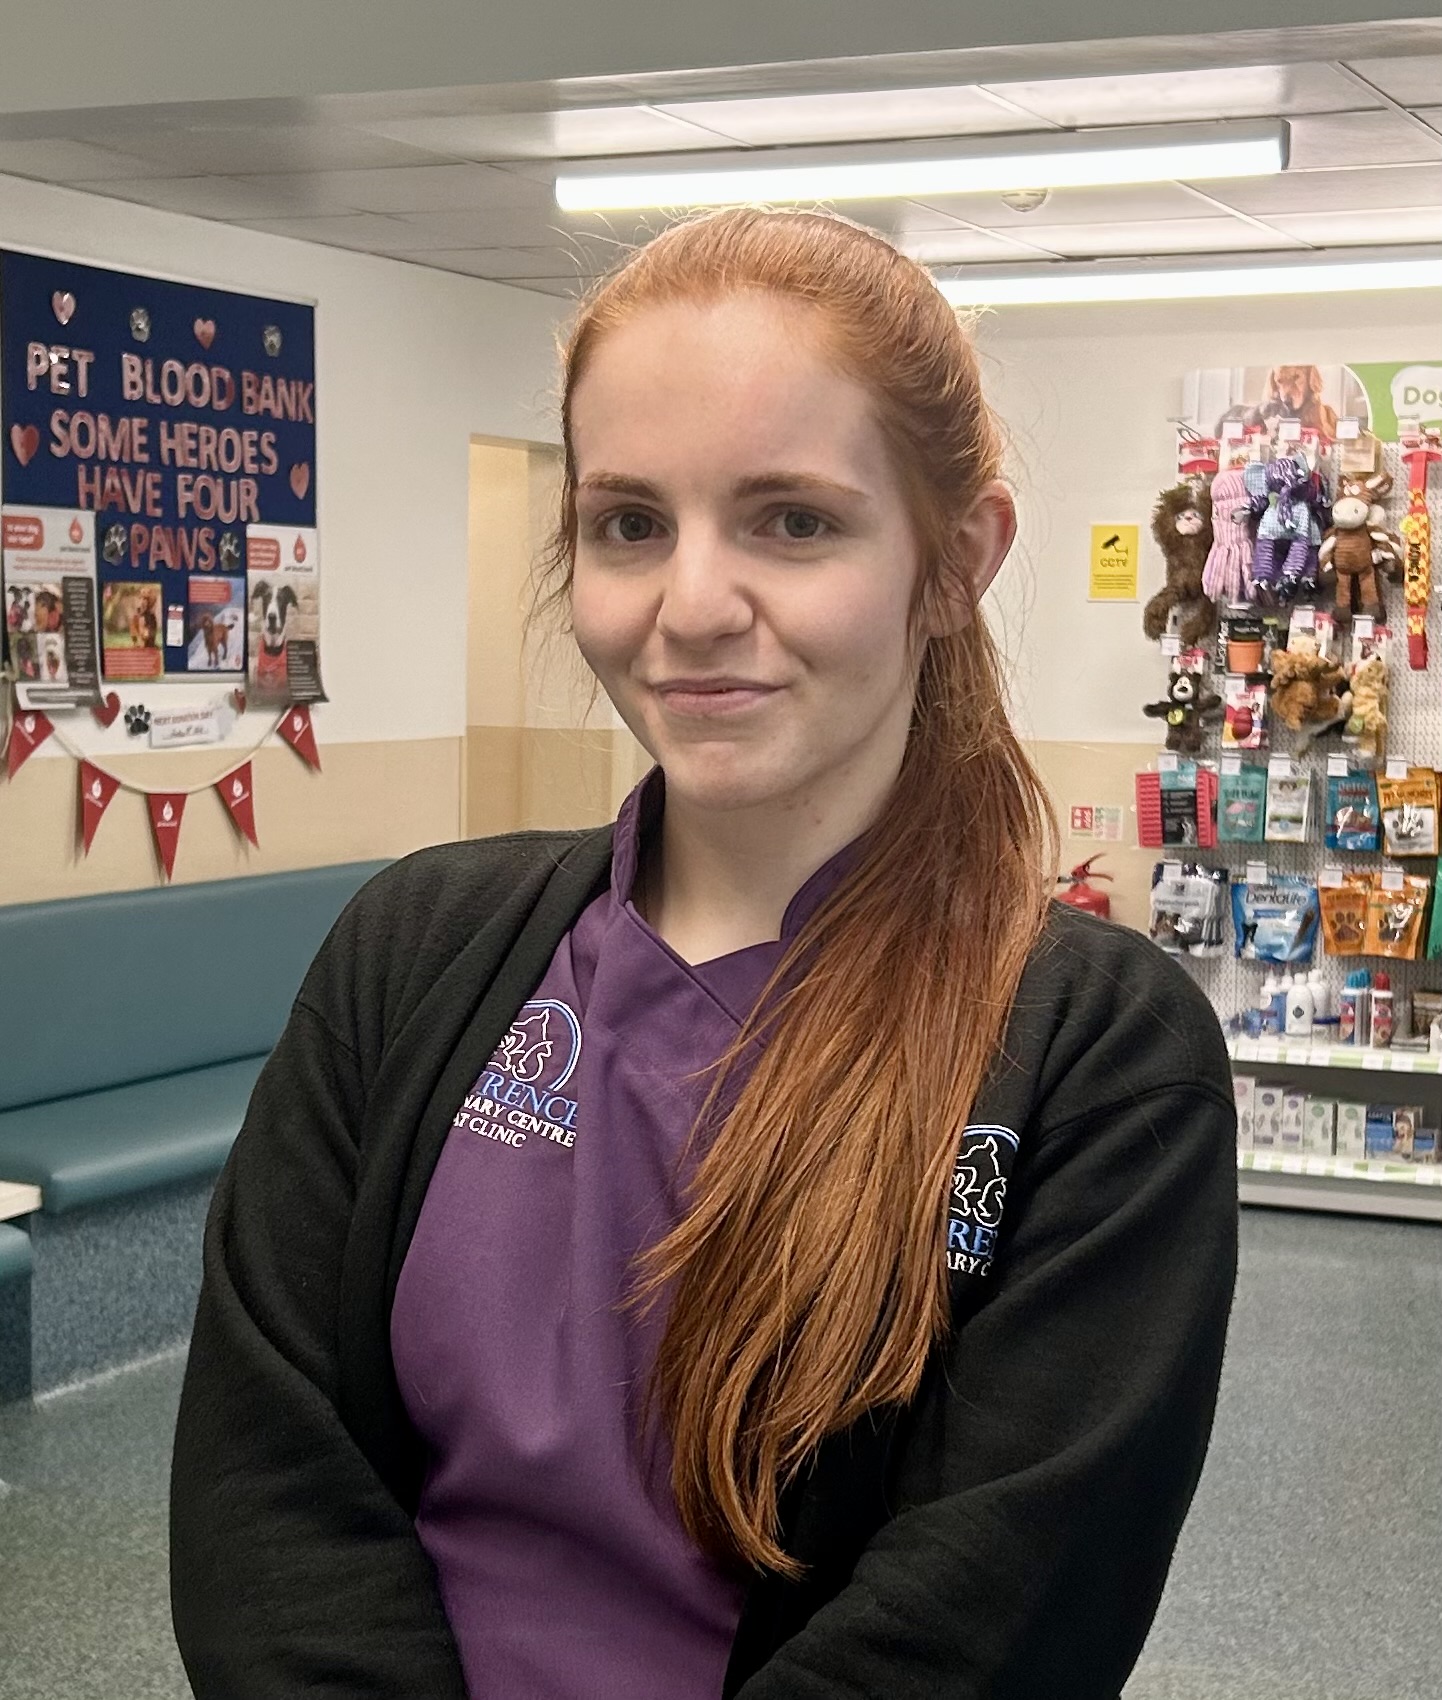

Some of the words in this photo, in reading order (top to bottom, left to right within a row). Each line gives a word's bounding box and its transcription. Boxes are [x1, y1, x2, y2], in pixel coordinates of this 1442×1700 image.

[26, 341, 95, 397] PET
[121, 352, 235, 411] BLOOD
[241, 370, 314, 423] BANK
[1404, 386, 1442, 408] Do
[50, 409, 149, 463] SOME
[160, 420, 278, 475] HEROES
[78, 464, 162, 517] HAVE
[177, 473, 260, 524] FOUR
[130, 523, 216, 570] PAWS
[1099, 557, 1128, 568] CCTV
[469, 1117, 527, 1149] CLINIC
[507, 1110, 577, 1148] CENTRE
